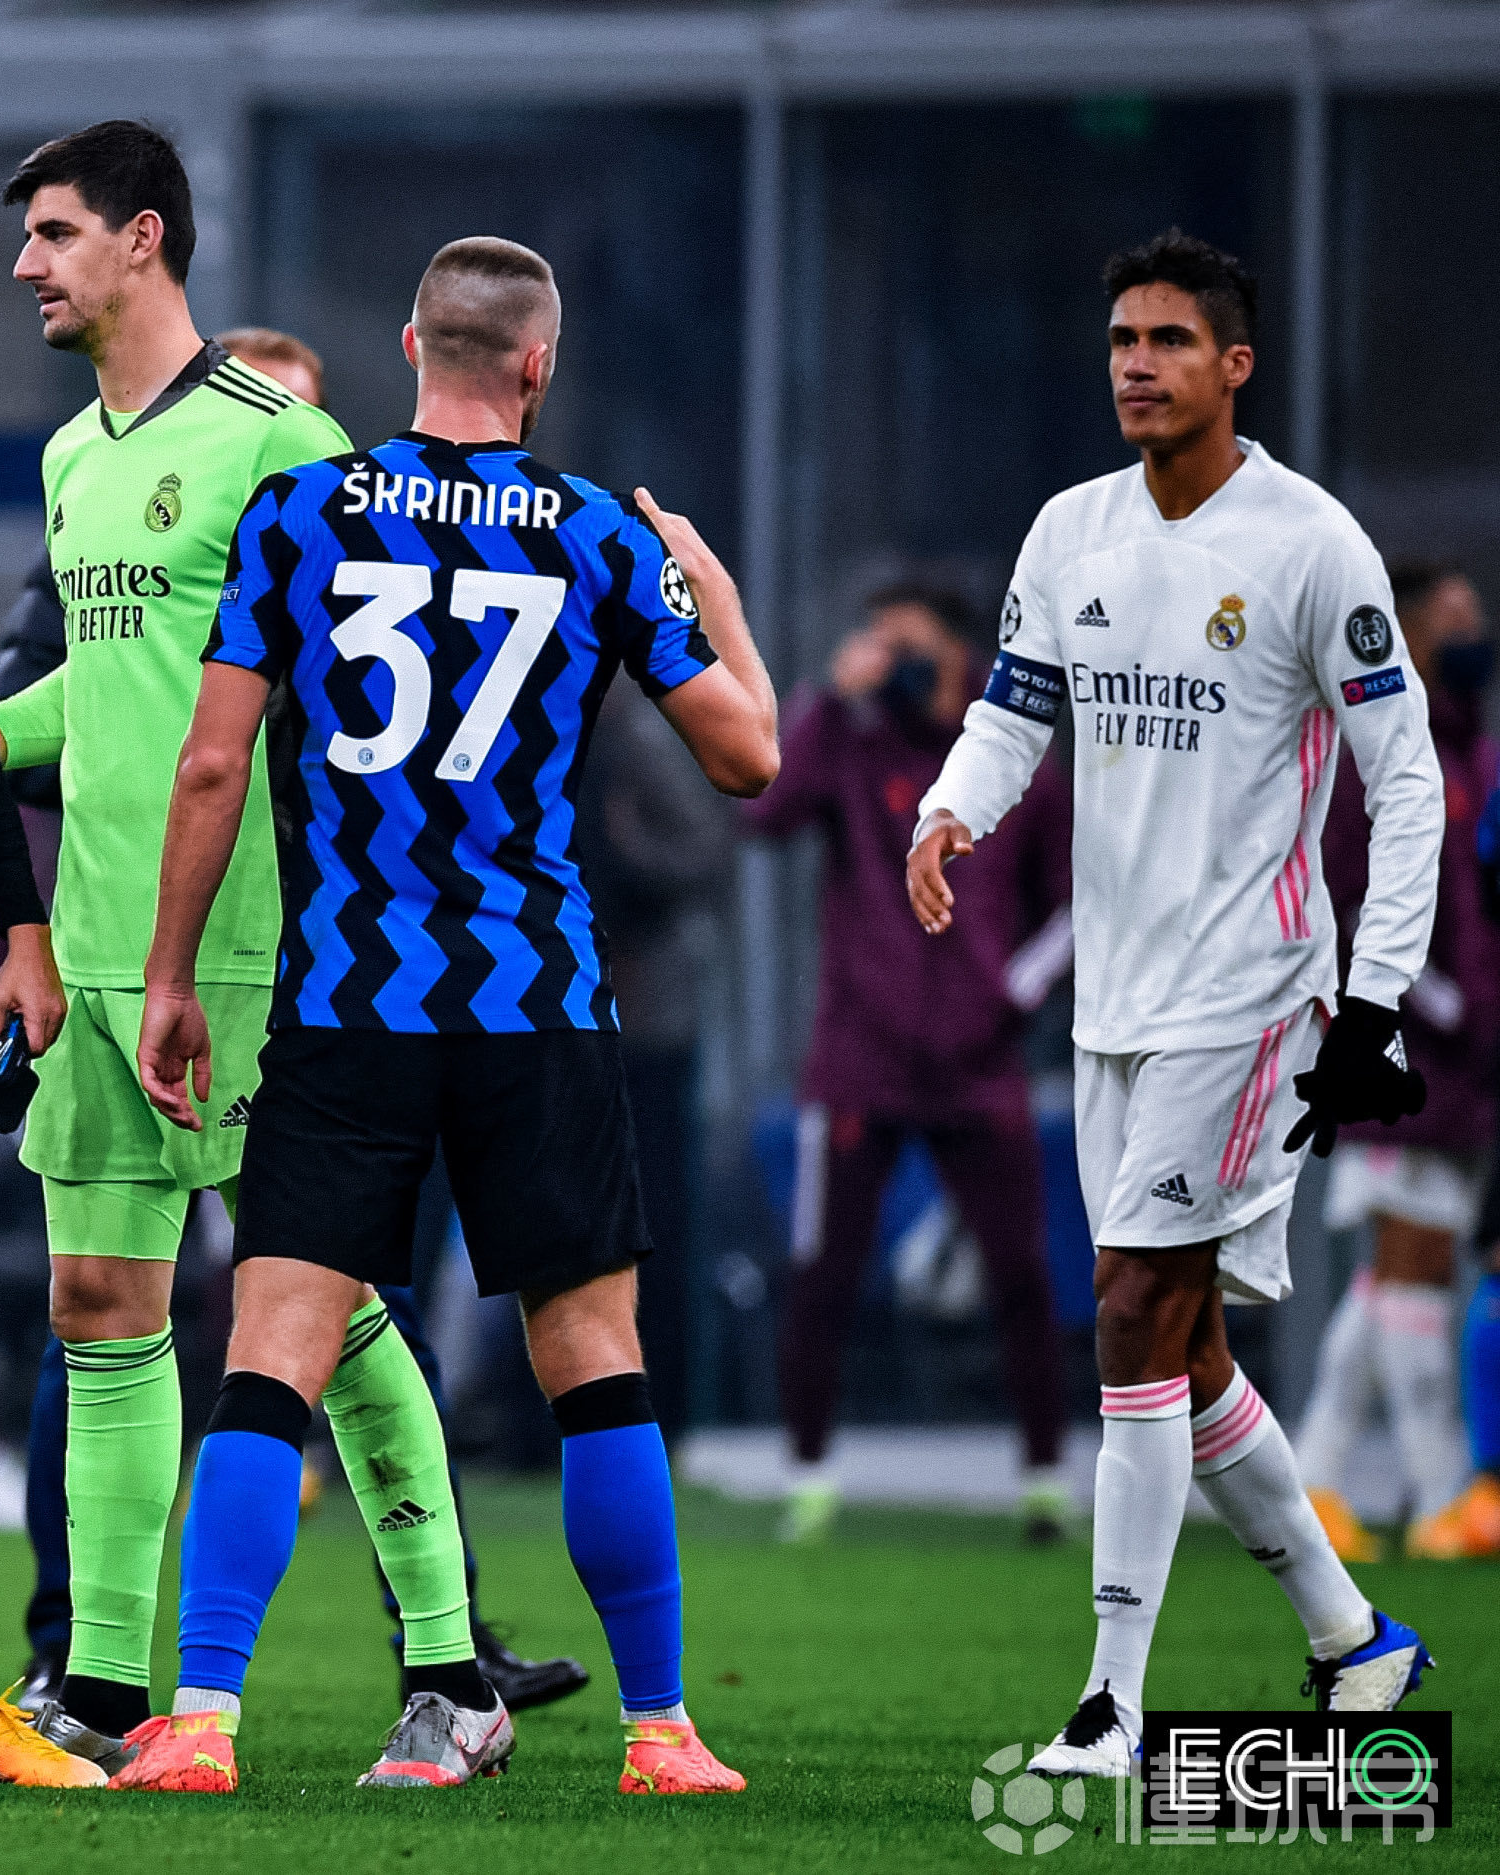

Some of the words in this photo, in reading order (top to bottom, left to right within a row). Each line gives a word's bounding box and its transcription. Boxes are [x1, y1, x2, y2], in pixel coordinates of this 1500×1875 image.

[343, 463, 562, 529] ŠKRINIAR
[54, 556, 171, 601] mirates
[79, 605, 145, 643] BETTER
[1362, 632, 1382, 651] 13
[326, 560, 567, 782] 37
[1009, 666, 1030, 683] NO
[1031, 674, 1047, 689] TO
[1071, 662, 1226, 714] Emirates
[1364, 674, 1403, 694] RESPE
[1096, 712, 1128, 746] FLY
[1150, 1187, 1194, 1207] adidas
[376, 1511, 437, 1532] adidas
